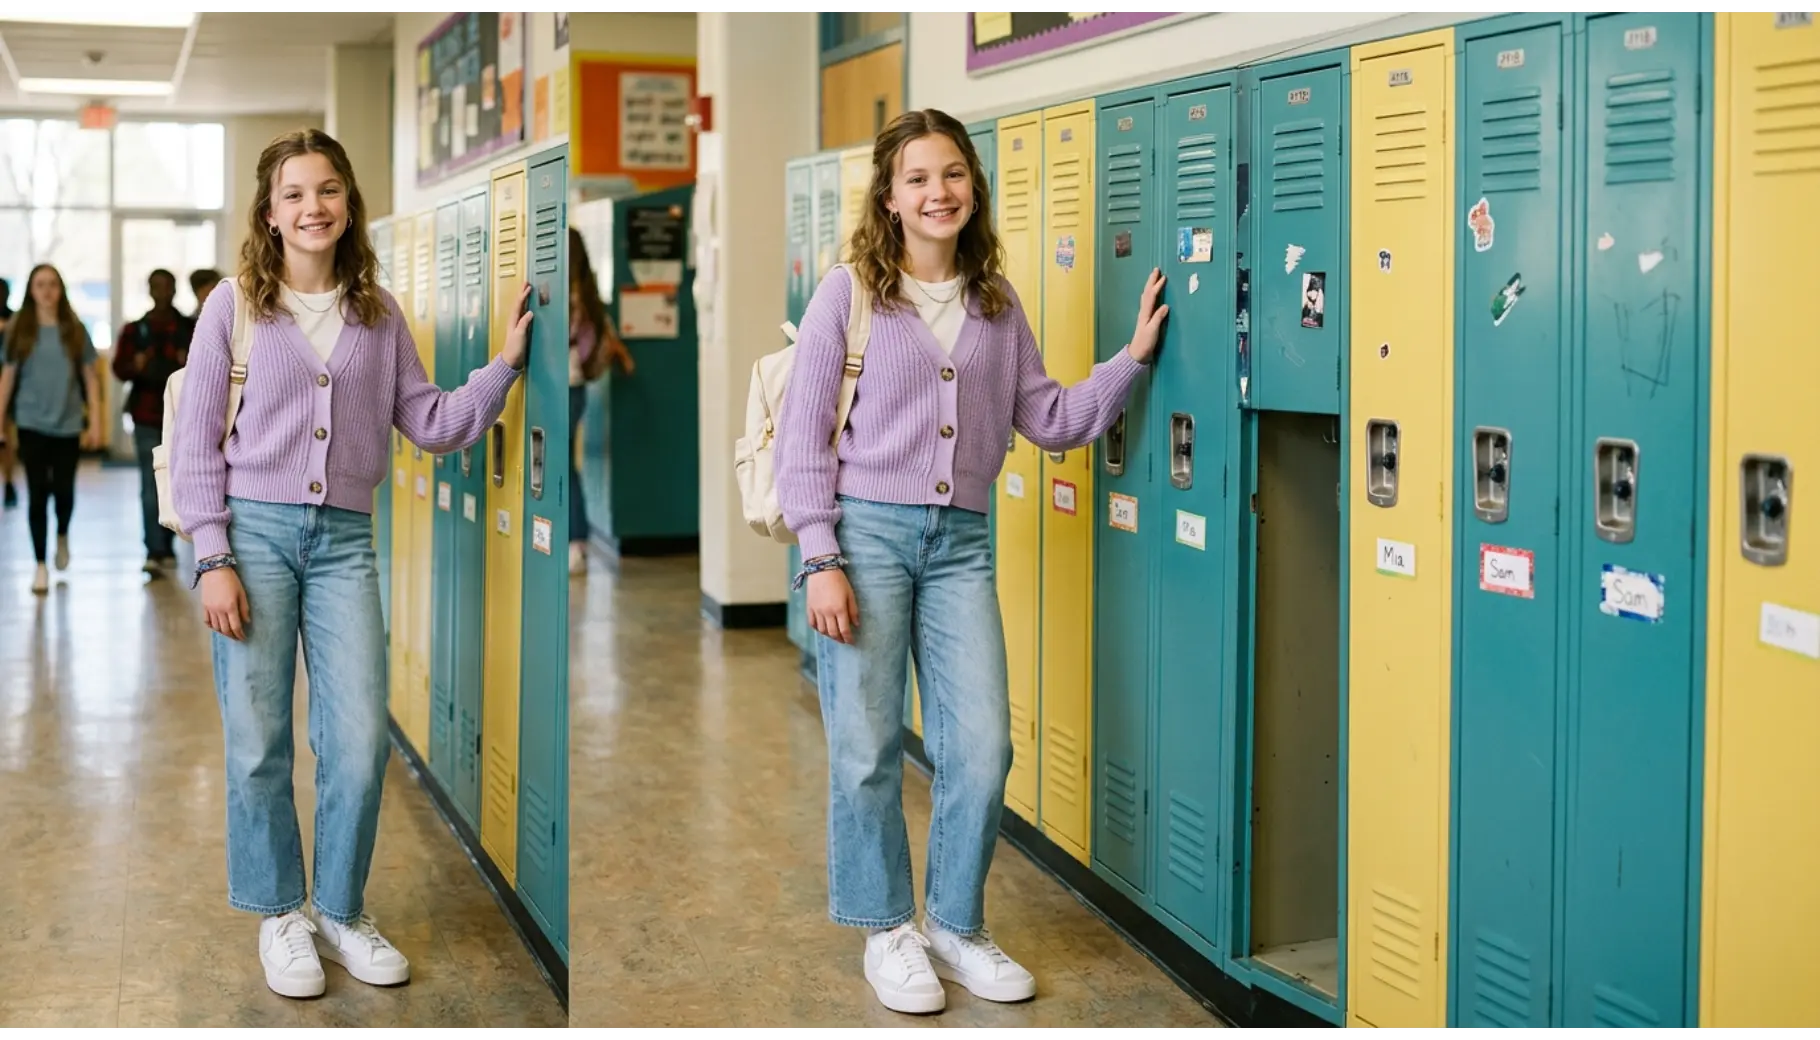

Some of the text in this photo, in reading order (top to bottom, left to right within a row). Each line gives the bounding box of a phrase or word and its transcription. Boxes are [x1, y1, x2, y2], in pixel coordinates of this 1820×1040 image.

[1384, 545, 1404, 567] Mia
[1490, 558, 1516, 582] Sam
[1613, 578, 1649, 611] Sam
